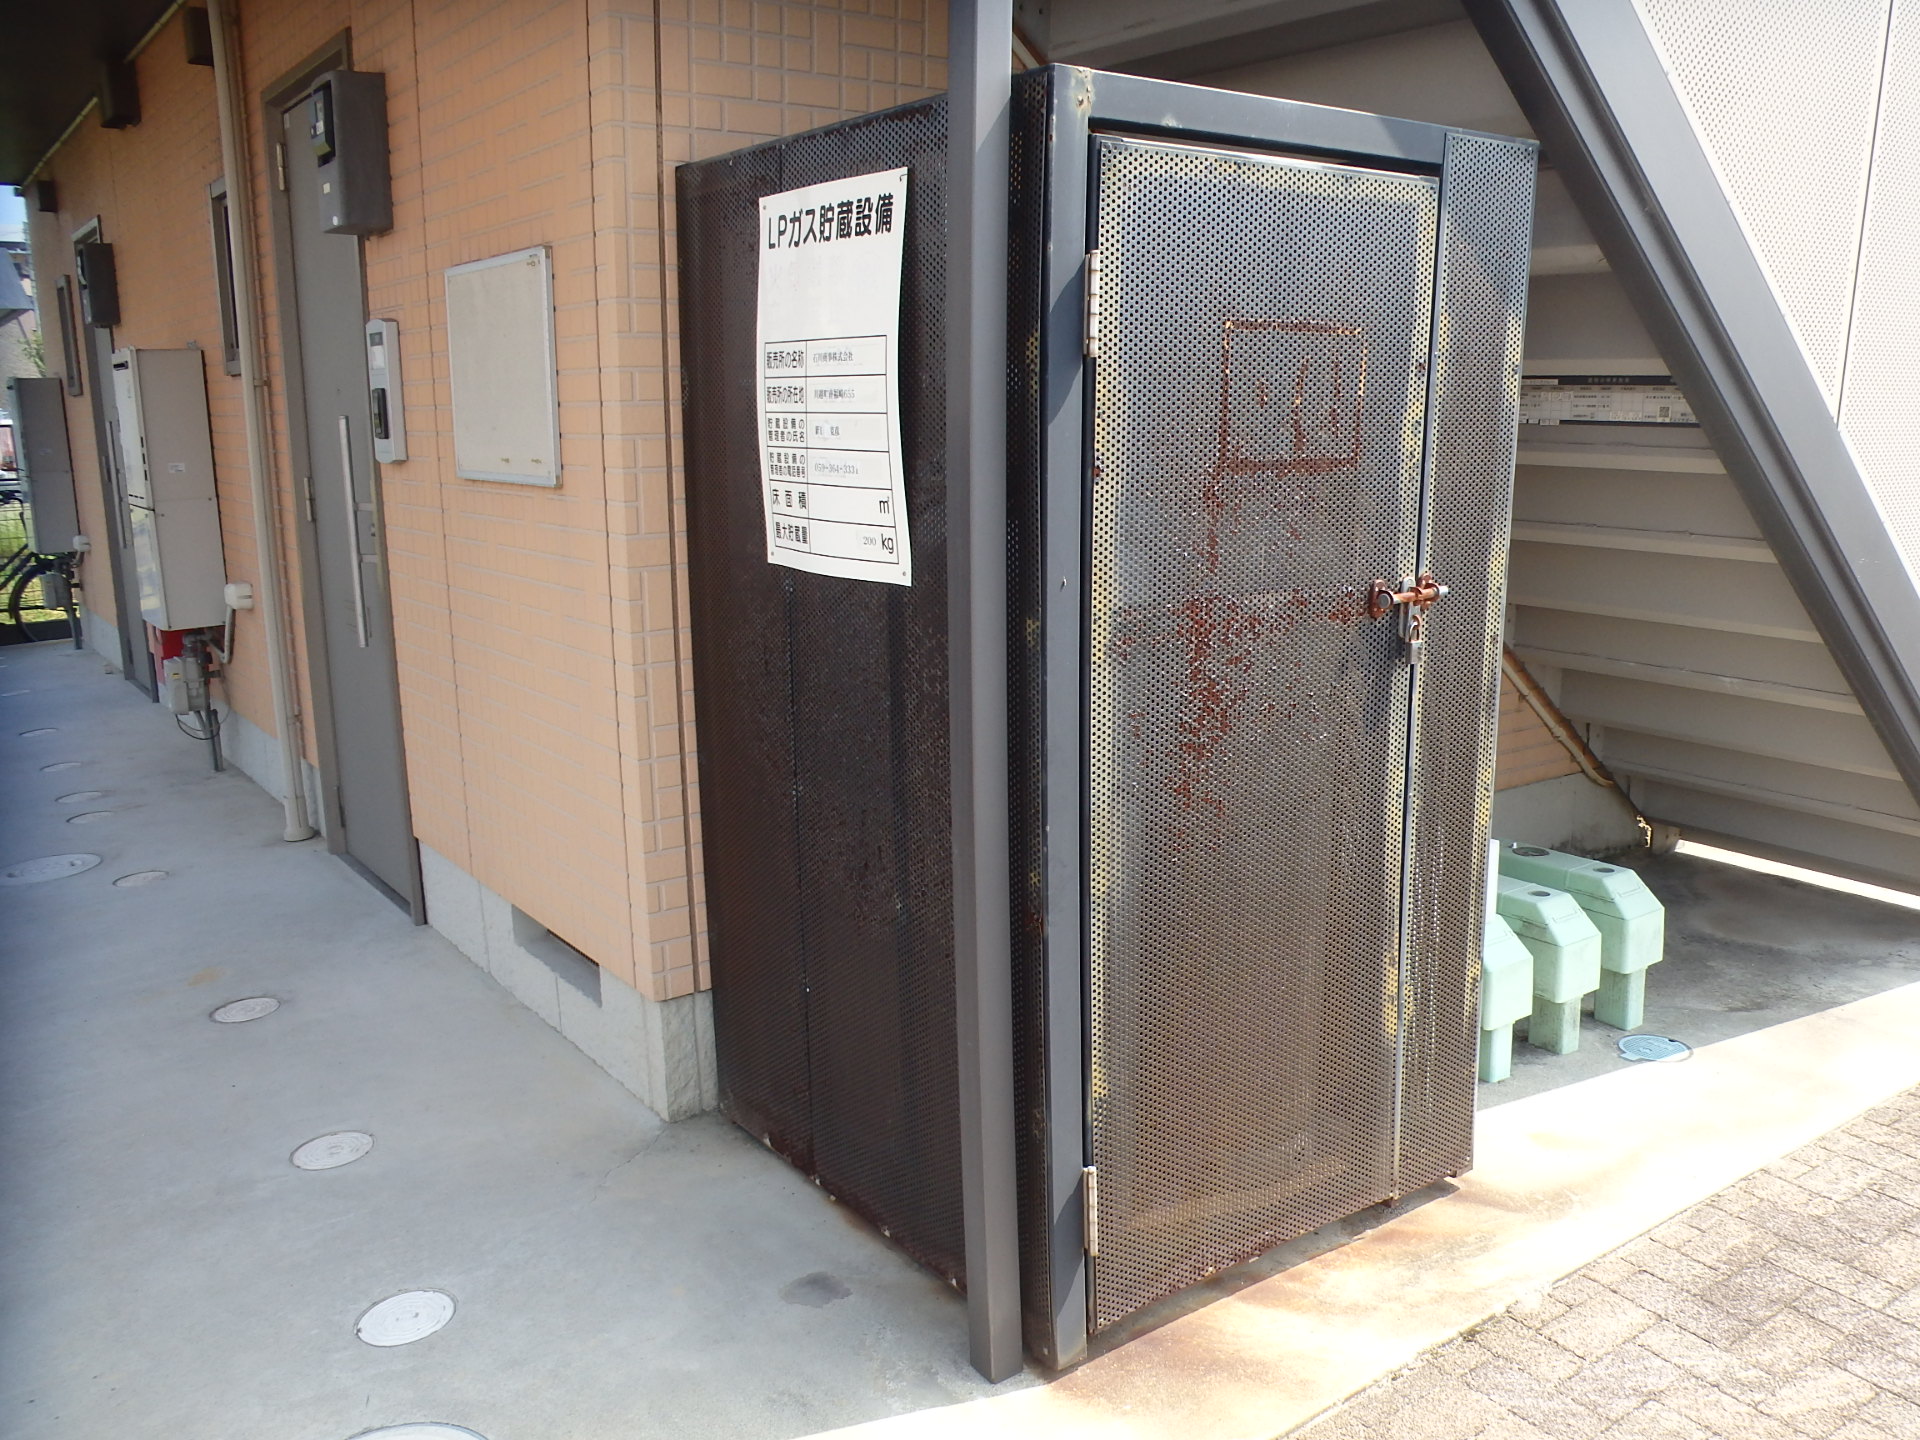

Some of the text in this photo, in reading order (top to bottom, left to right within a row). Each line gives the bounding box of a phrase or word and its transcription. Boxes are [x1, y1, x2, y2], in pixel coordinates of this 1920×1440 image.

[768, 193, 893, 249] LPガス貯蔵設備
[881, 533, 894, 554] kg
